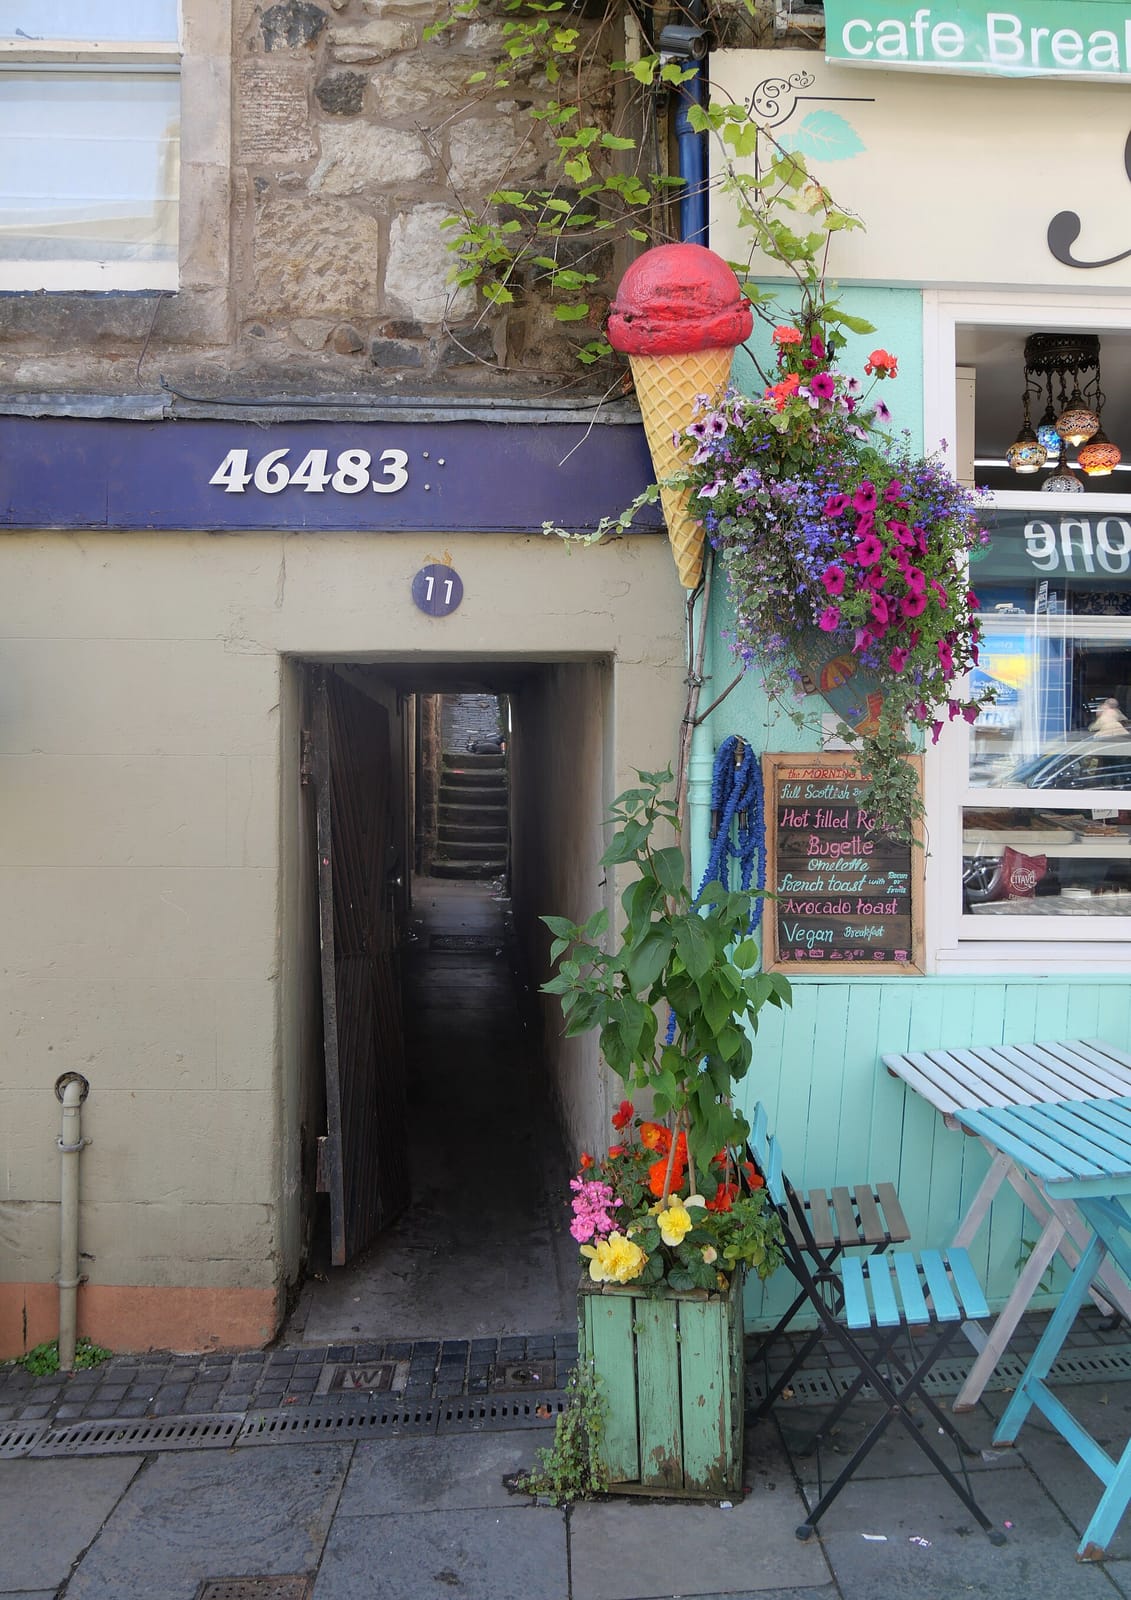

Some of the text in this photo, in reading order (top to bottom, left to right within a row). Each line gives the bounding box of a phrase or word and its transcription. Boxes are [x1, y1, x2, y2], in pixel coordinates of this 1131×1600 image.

[842, 9, 965, 57] cafe
[208, 448, 409, 494] 46483
[424, 576, 453, 605] 11
[780, 783, 801, 799] full
[804, 783, 850, 799] Scottish
[780, 808, 810, 828] Hot
[814, 808, 849, 829] filled
[807, 834, 874, 858] Bugette
[808, 858, 870, 872] Omelette
[827, 874, 868, 892] toast
[784, 898, 898, 914] Avocado toast
[782, 921, 885, 949] Vegan Breakfast
